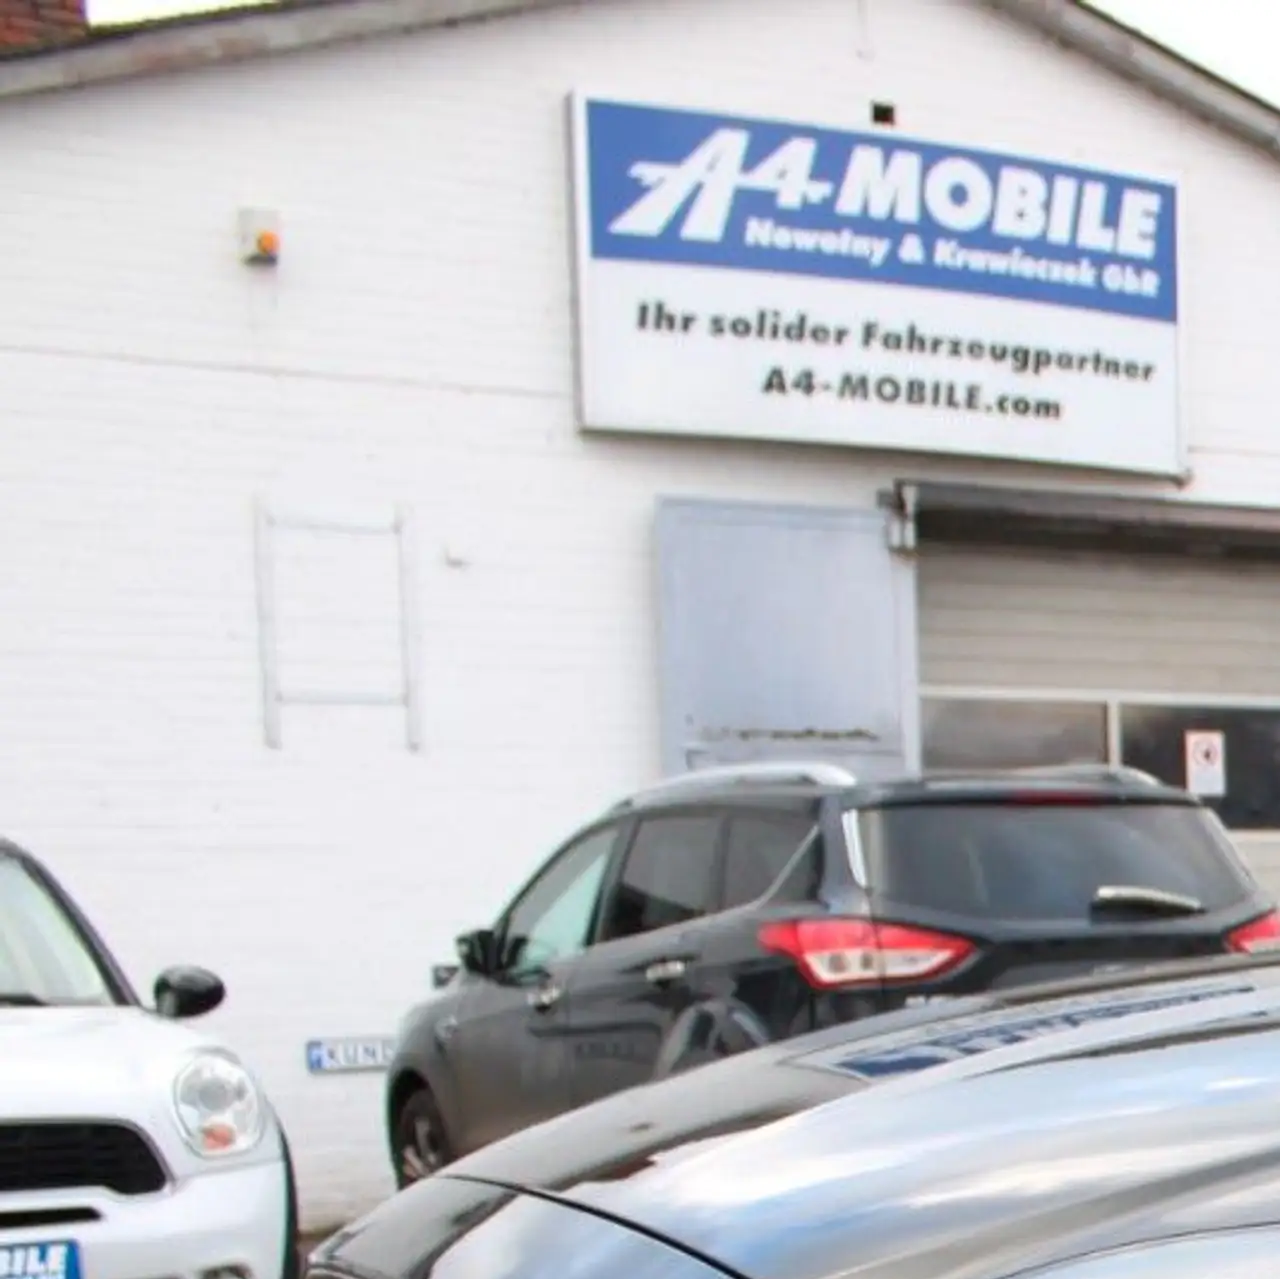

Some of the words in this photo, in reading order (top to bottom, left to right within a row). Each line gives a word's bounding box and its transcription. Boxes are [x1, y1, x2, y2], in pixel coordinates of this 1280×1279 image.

[897, 232, 925, 265] &
[636, 301, 695, 333] Ihr
[709, 309, 850, 346] solider
[861, 321, 1156, 381] Fahrzeugpartner
[762, 365, 1061, 419] A4-MOBILE.com
